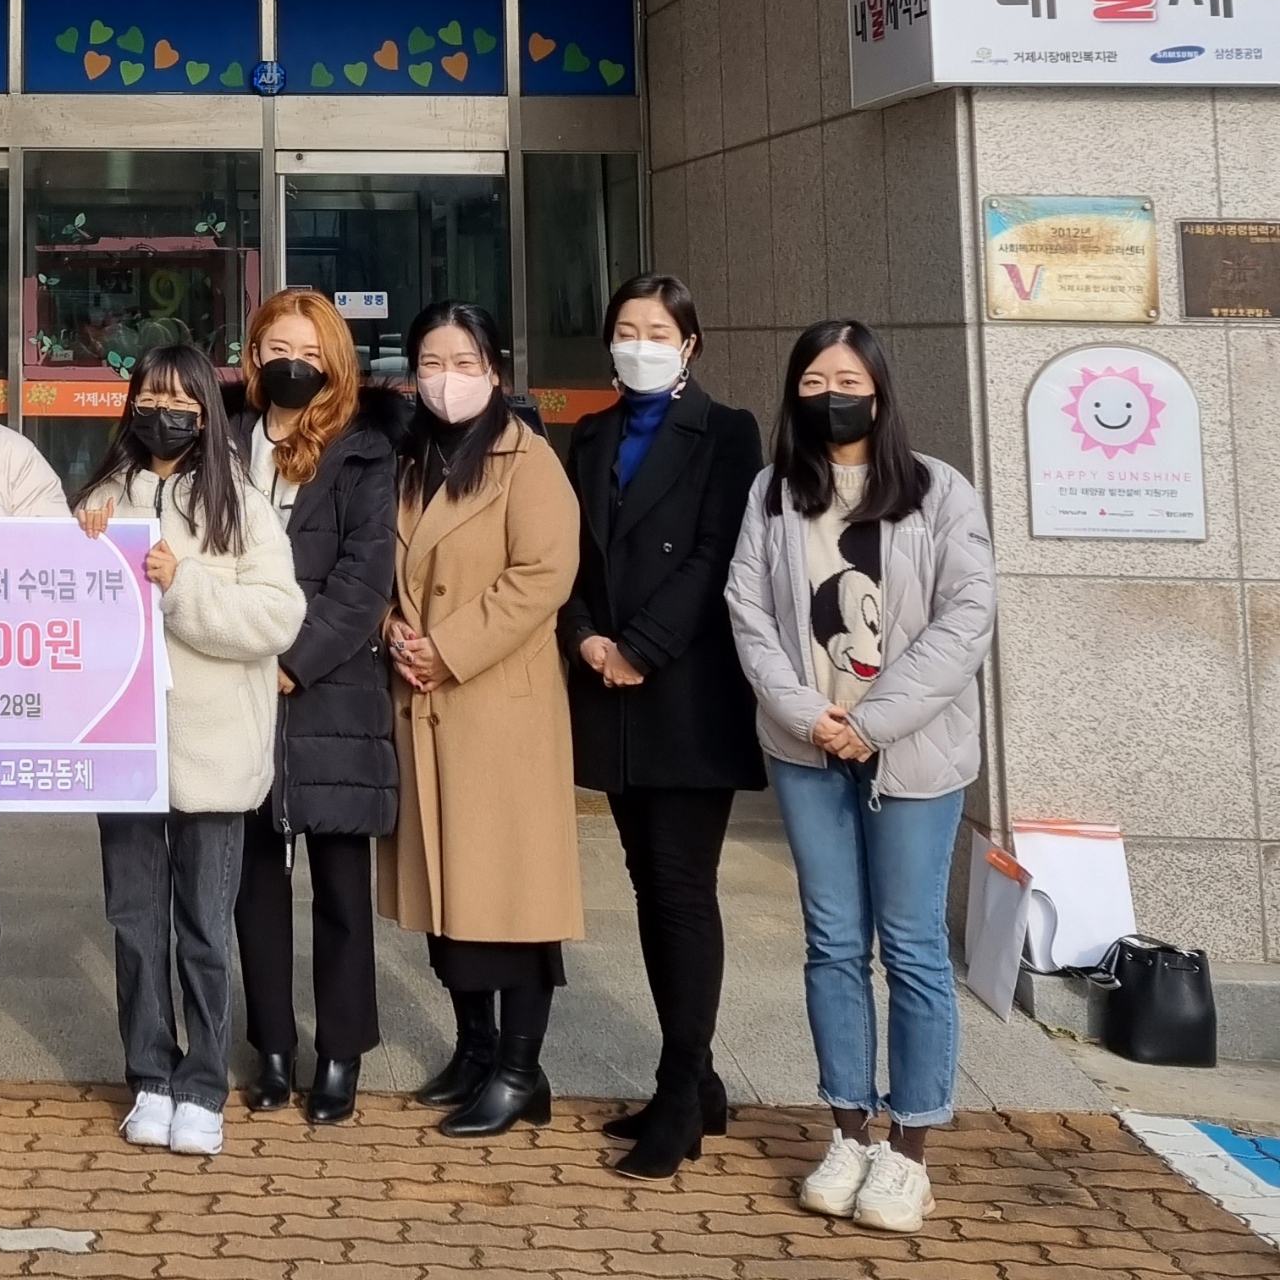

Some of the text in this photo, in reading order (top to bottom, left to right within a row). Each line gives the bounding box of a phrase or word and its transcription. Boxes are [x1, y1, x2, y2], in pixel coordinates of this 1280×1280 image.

[1012, 51, 1118, 63] 거제시장애인복지관
[1155, 50, 1200, 59] SAMSUNG
[1214, 48, 1263, 60] 삼성중공업
[1042, 470, 1192, 482] HAPPY SUNSHINE
[17, 568, 77, 601] 수익금
[86, 569, 125, 602] 기부
[0, 693, 43, 719] 28일
[0, 758, 95, 791] 교육공동체
